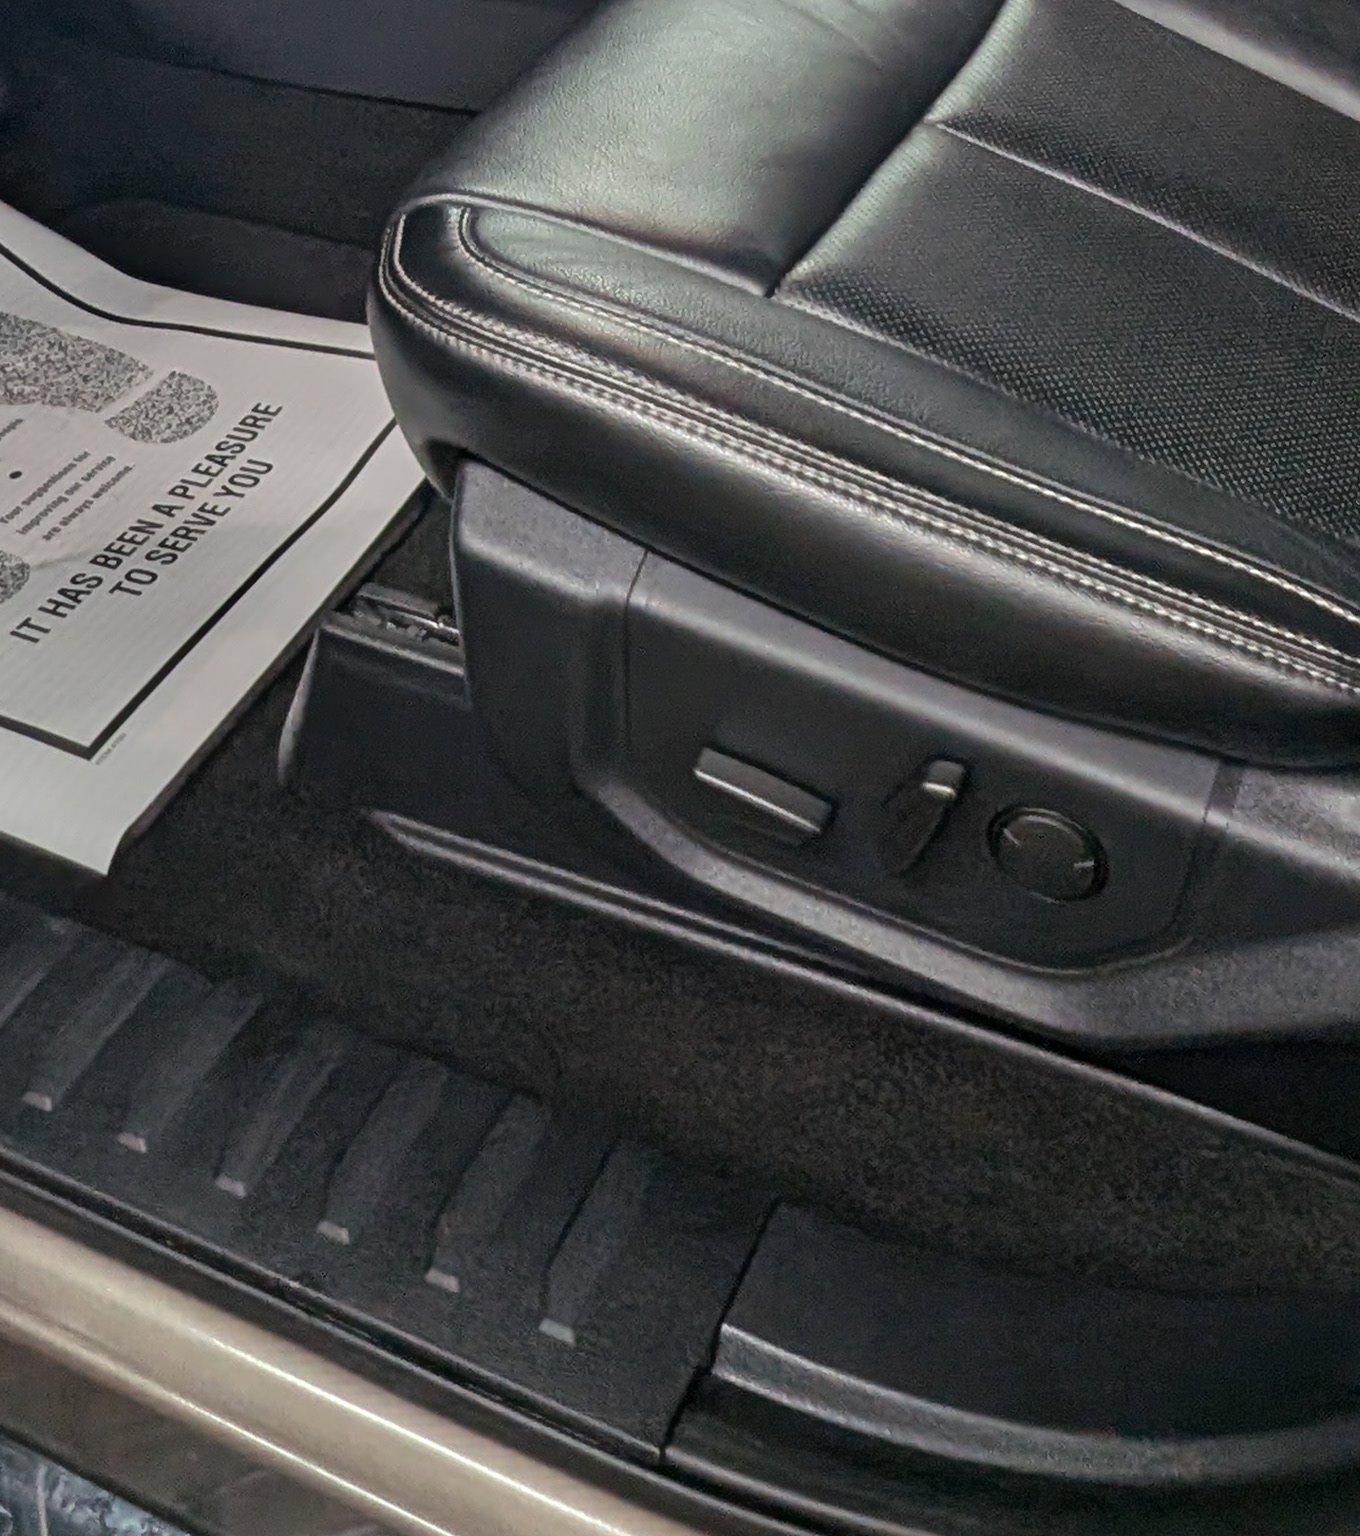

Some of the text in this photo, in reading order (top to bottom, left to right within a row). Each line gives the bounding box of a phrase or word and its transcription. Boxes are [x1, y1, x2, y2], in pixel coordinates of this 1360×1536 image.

[9, 402, 283, 644] IT HAS BEEN A PLEASURE
[108, 459, 274, 596] TO SERVE YOU
